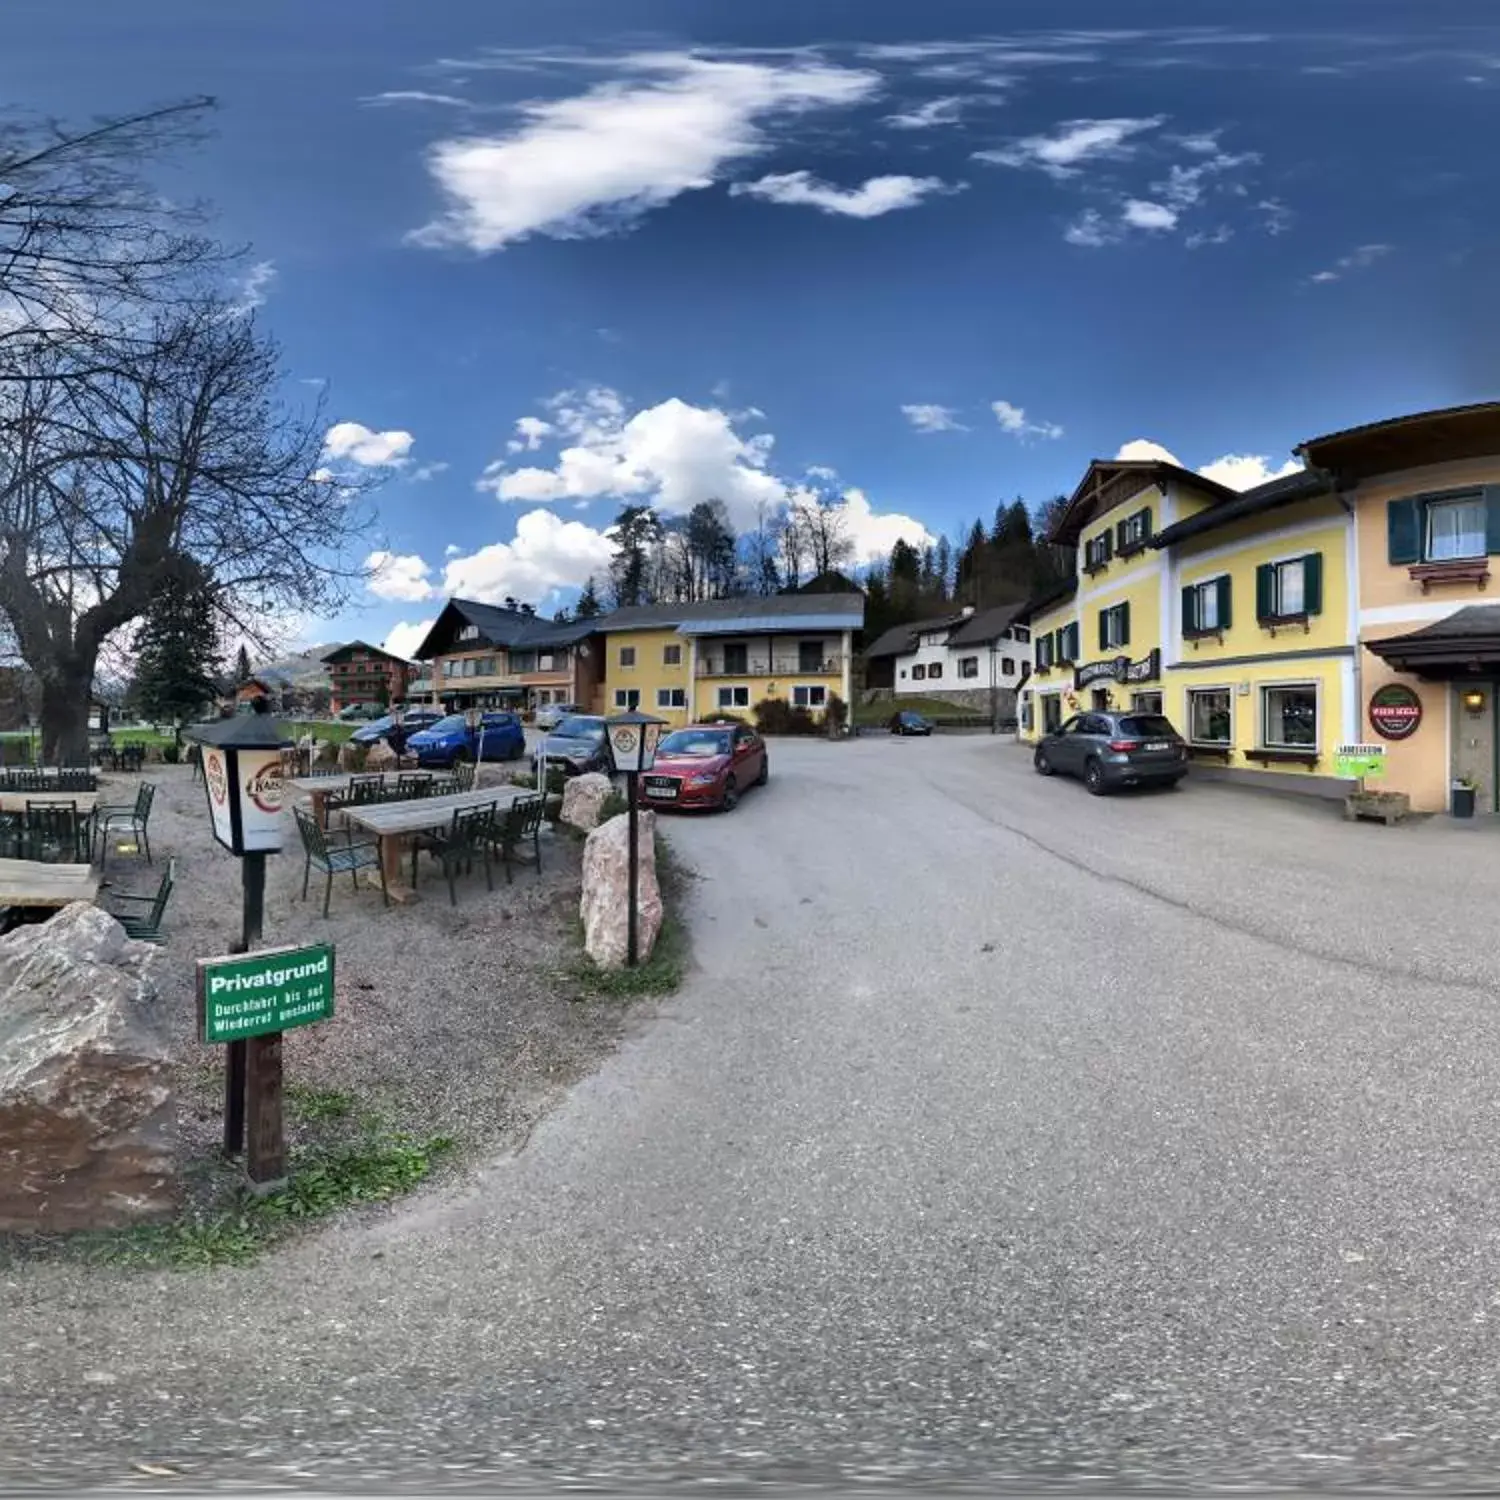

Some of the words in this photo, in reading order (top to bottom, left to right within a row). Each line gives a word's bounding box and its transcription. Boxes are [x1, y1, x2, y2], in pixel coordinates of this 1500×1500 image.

[211, 955, 328, 994] Privatgrund
[215, 995, 277, 1017] Durchfahrt
[285, 991, 301, 1004] bis
[307, 983, 323, 998] auf
[280, 999, 325, 1021] gestattet
